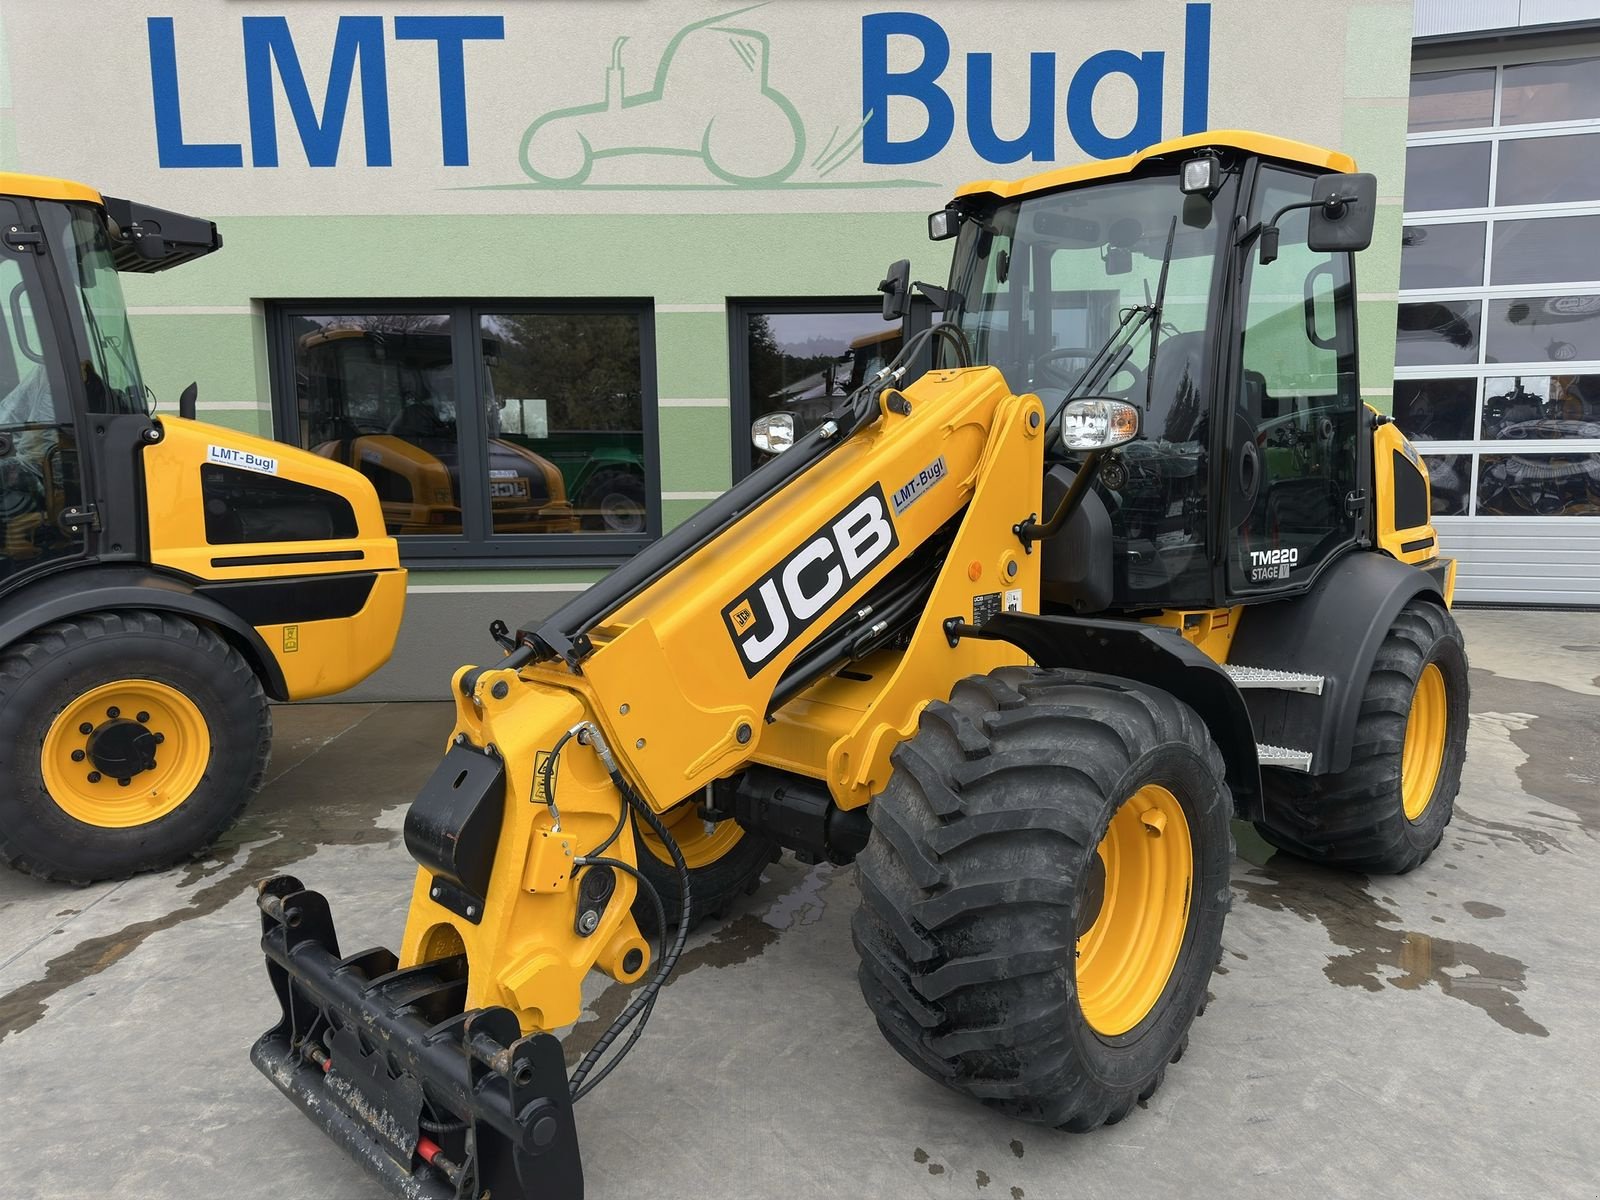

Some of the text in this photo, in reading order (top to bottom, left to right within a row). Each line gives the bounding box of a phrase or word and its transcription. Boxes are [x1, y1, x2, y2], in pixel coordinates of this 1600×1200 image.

[148, 16, 504, 168] LMT
[212, 447, 274, 470] LMT-Bugl
[893, 457, 943, 507] LMT-Bugl
[1250, 548, 1298, 566] TM220
[743, 497, 891, 662] JCB
[1252, 566, 1278, 580] STAGE
[737, 609, 750, 625] JCB
